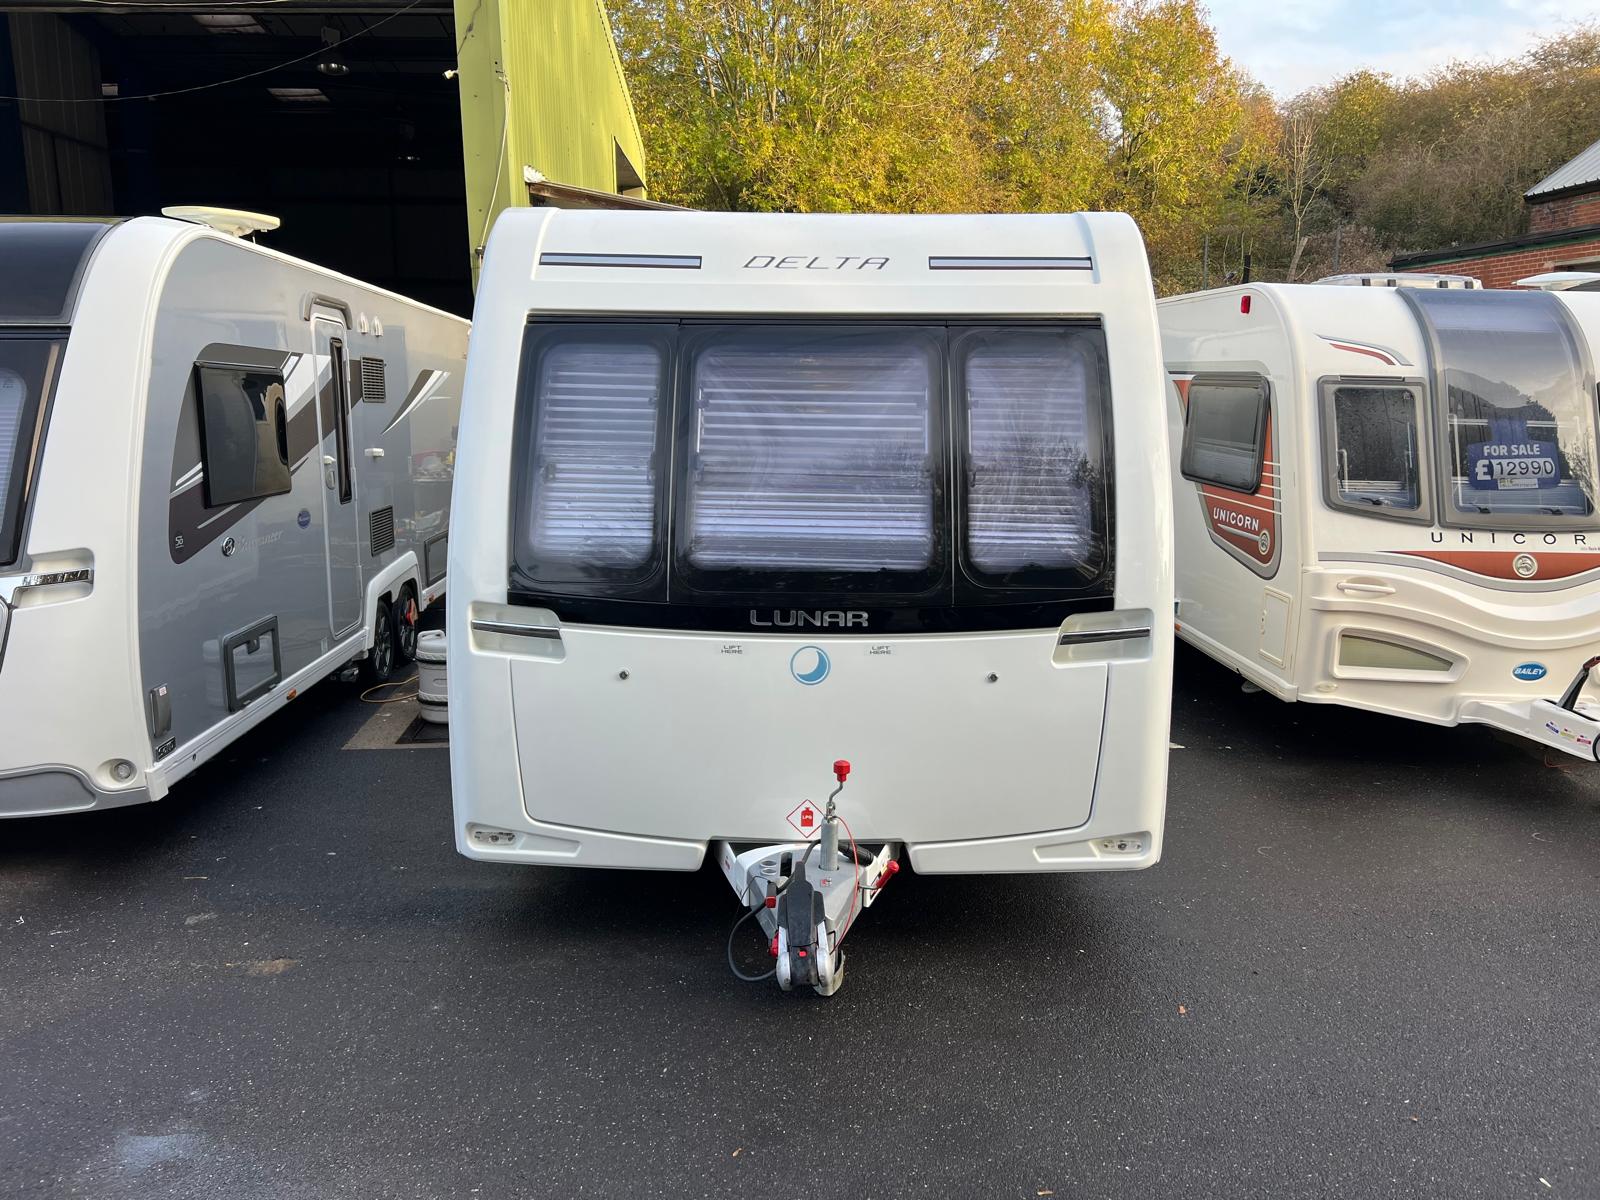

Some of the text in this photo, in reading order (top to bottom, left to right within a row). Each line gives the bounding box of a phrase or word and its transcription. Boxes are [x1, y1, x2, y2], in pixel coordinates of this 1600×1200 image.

[742, 255, 890, 270] DELTA
[1483, 443, 1541, 457] FOR SALE
[1213, 507, 1259, 531] UNICORN
[750, 610, 869, 627] LUNAR
[1514, 667, 1545, 676] BAILEY
